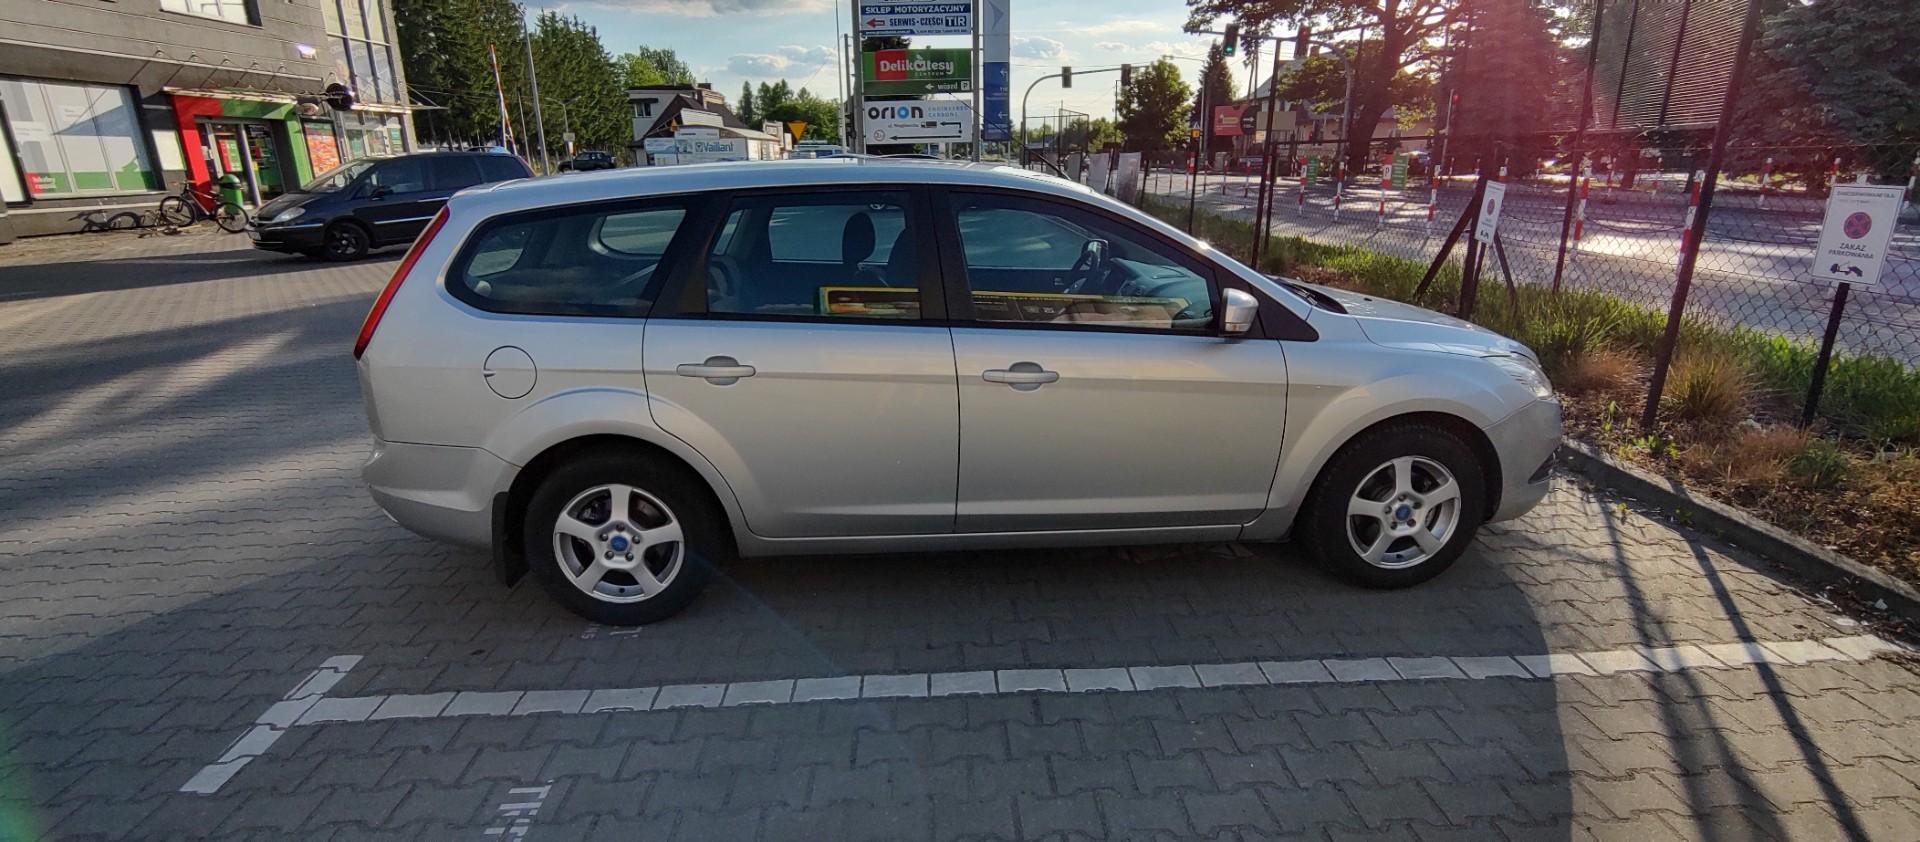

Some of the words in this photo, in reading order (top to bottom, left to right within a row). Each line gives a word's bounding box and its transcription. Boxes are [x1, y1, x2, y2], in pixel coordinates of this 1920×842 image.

[865, 6, 891, 14] SKLEP
[894, 5, 965, 14] MOTORYZACYJNY
[889, 18, 916, 27] SERWIS
[946, 16, 966, 27] TIR
[879, 60, 954, 75] Delikatesy
[703, 142, 734, 152] Vaillant
[1839, 242, 1867, 251] ZAKAZ
[1828, 249, 1874, 259] PARKOWANIA
